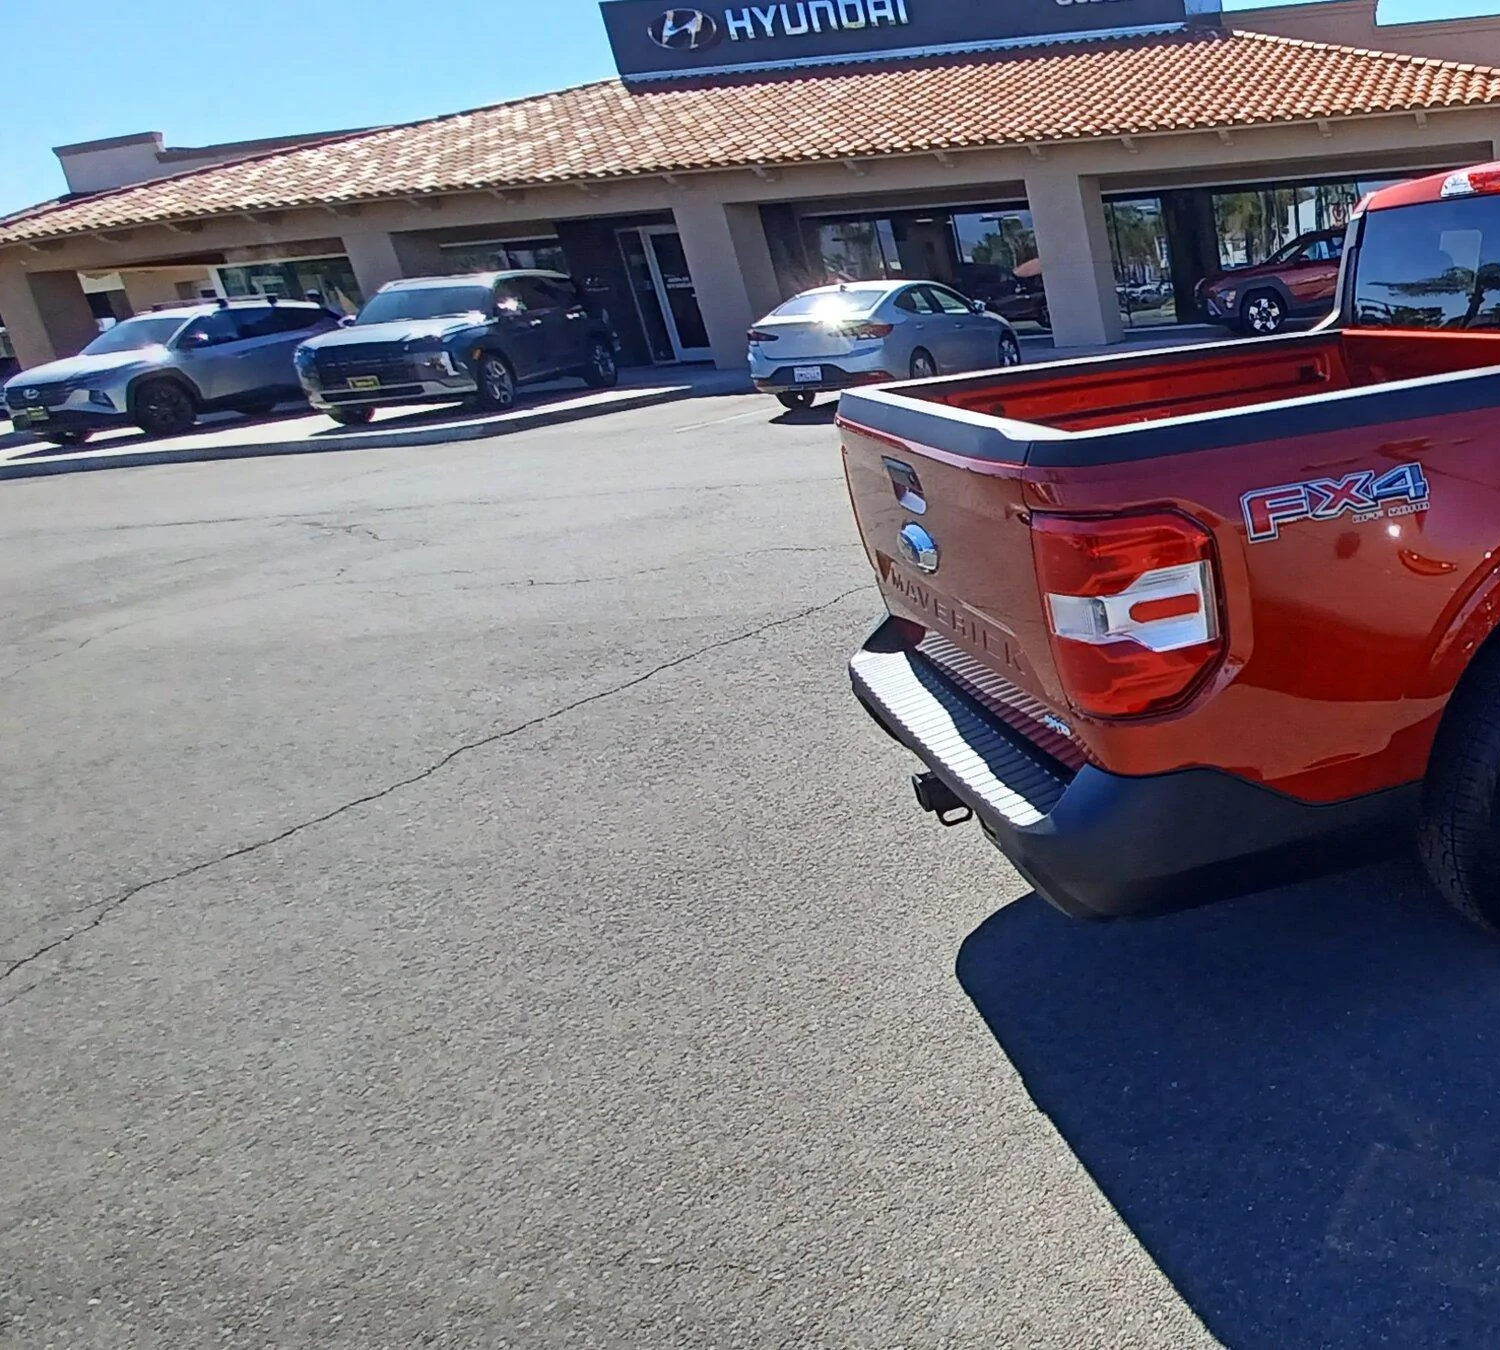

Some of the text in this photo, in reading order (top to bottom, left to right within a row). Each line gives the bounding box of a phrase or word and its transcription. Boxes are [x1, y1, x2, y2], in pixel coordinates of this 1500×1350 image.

[724, 0, 909, 41] HYUNDAI
[1239, 461, 1430, 544] FX4
[889, 561, 1026, 675] MAVERICK
